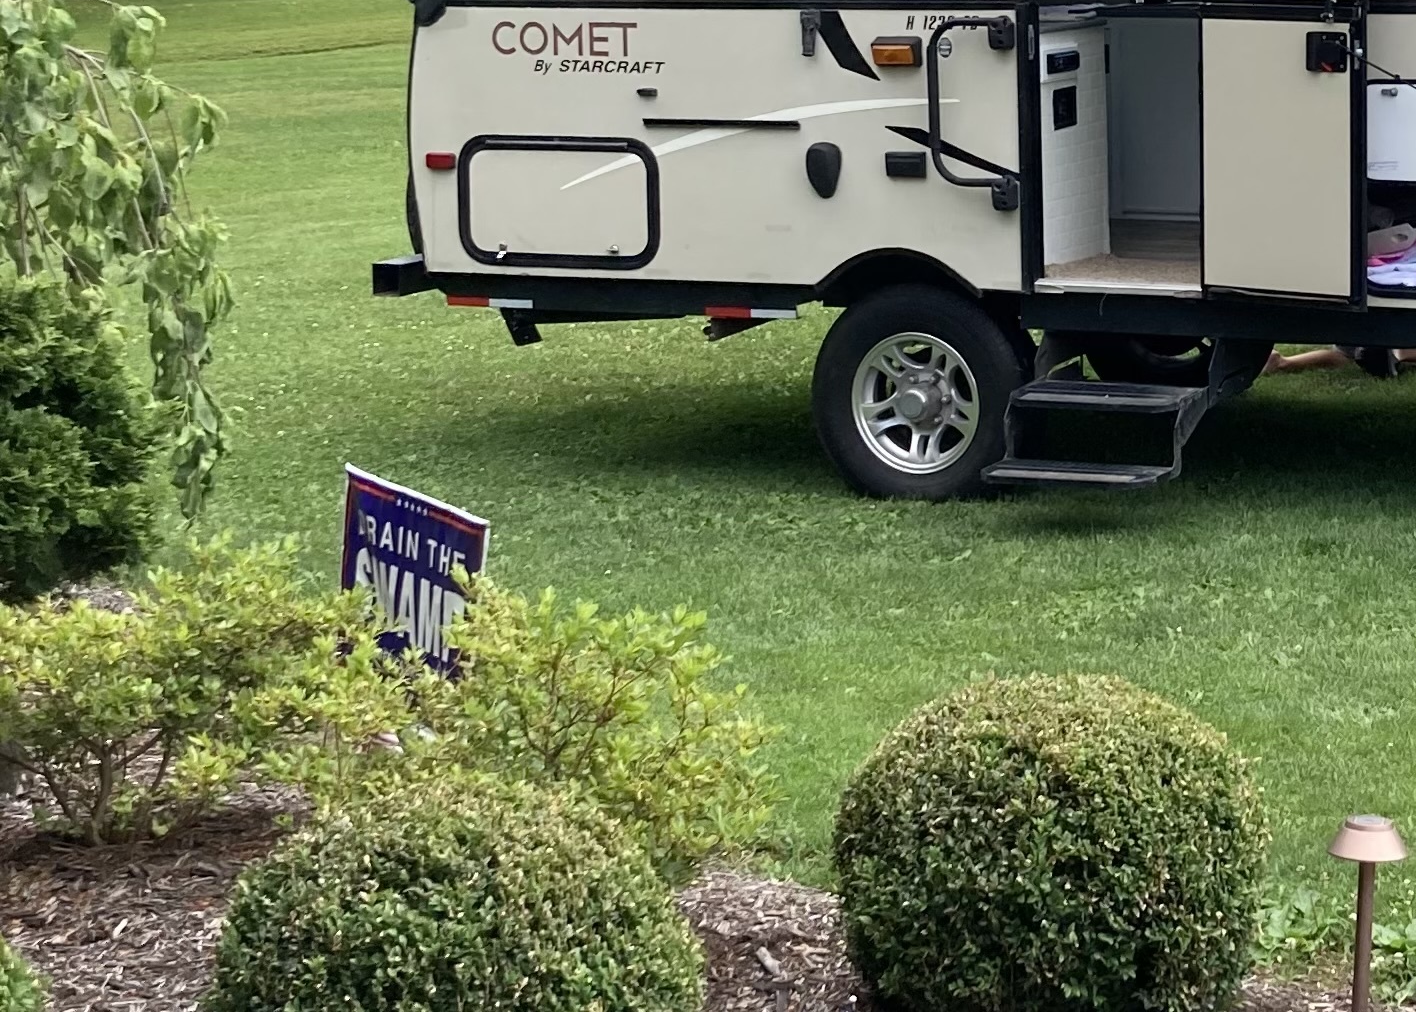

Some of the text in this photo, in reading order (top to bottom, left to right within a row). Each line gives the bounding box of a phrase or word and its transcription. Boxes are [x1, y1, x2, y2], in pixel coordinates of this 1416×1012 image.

[906, 15, 915, 30] H
[492, 21, 637, 56] COMET
[534, 59, 665, 75] By STARCRAFT
